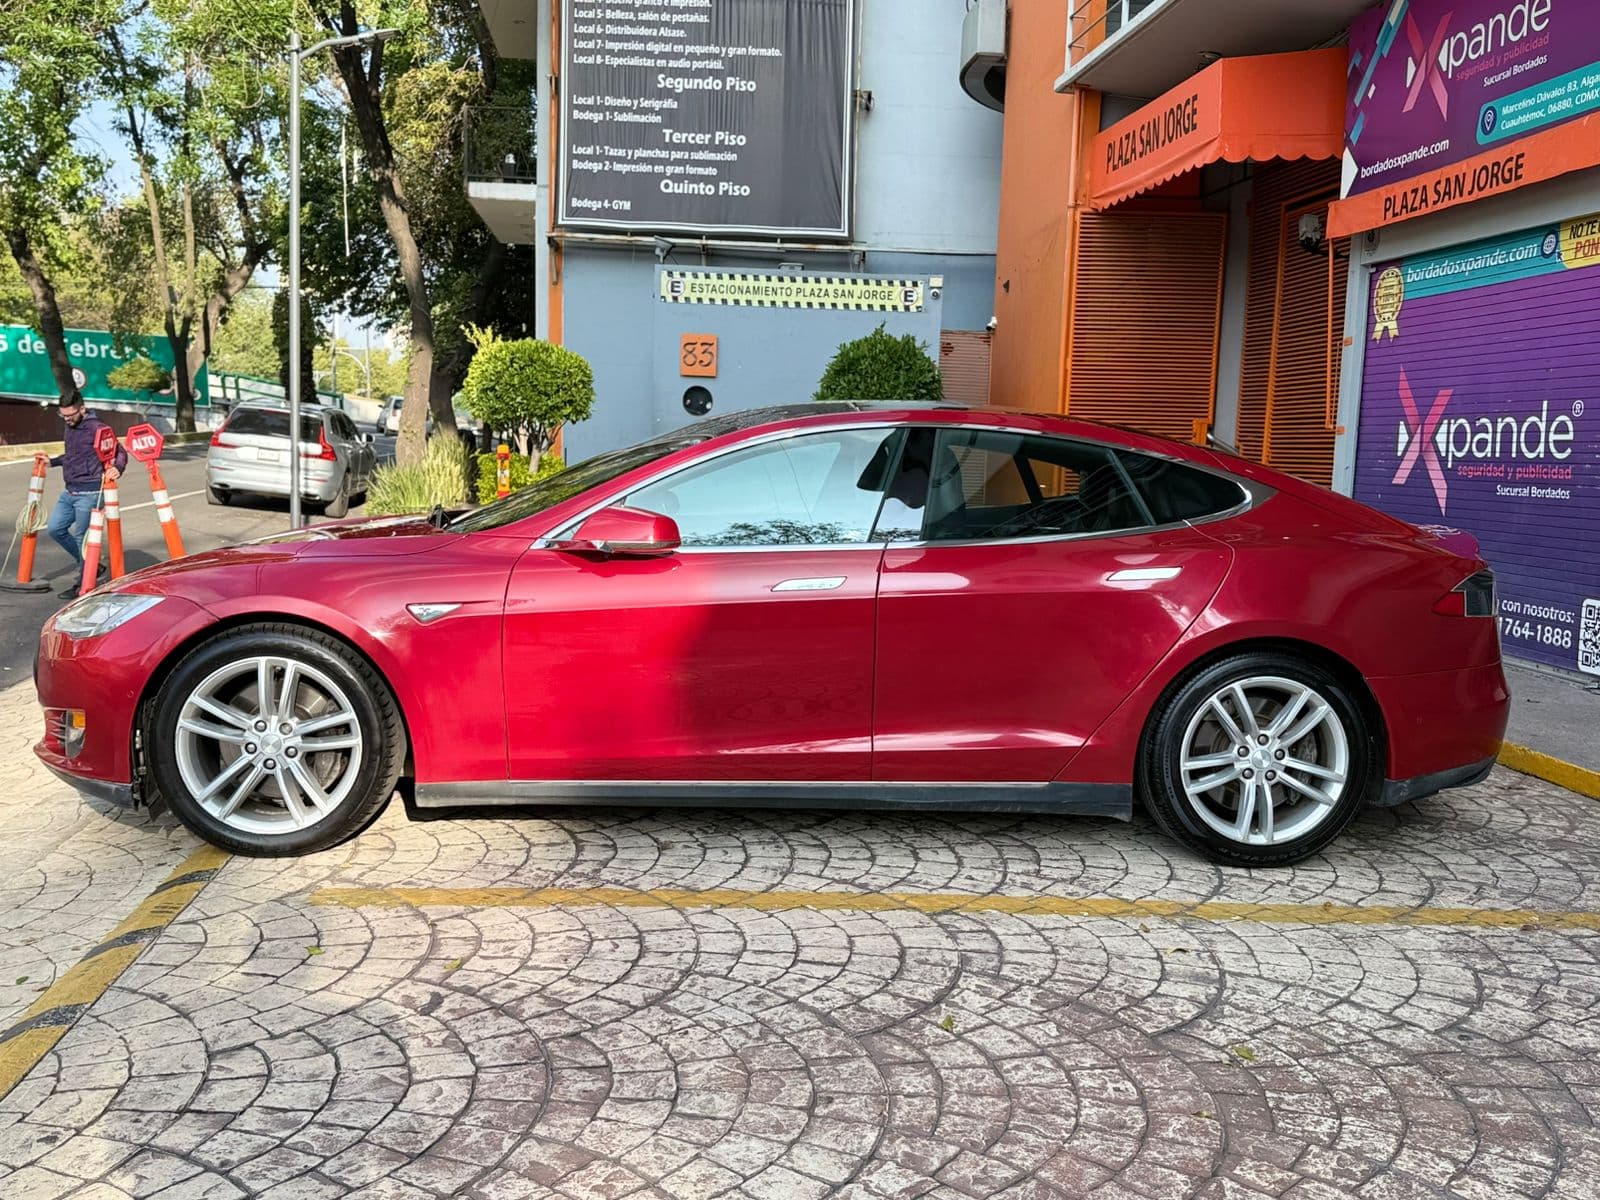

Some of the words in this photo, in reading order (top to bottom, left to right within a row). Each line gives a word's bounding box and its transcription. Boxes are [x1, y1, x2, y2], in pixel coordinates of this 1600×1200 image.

[574, 8, 595, 18] Local
[606, 9, 636, 21] Belleza,
[638, 11, 659, 21] salón
[661, 12, 671, 21] de
[672, 13, 710, 24] pestañas.
[574, 23, 595, 33] Local
[605, 24, 657, 36] Distribuidora
[574, 38, 595, 48] Local
[605, 40, 645, 52] Impresión
[646, 42, 672, 54] digital
[673, 44, 684, 52] en
[685, 44, 720, 56] pequeño
[721, 46, 727, 57] y
[728, 47, 747, 57] gran
[748, 45, 783, 56] formato.
[1503, 31, 1551, 63] publicidad
[573, 54, 595, 64] Local
[605, 55, 655, 68] Especialistas
[656, 59, 667, 67] en
[668, 58, 691, 68] audio
[692, 59, 725, 71] portátil.
[1483, 66, 1512, 87] Sucursal
[1512, 54, 1548, 76] Bordados
[657, 74, 722, 93] Segundo
[726, 77, 757, 92] Piso
[1580, 73, 1600, 89] Alga
[573, 95, 594, 105] Local
[605, 96, 632, 107] Diseño
[633, 99, 639, 109] y
[573, 110, 603, 123] Bodega
[614, 112, 662, 123] Sublimación
[662, 129, 711, 144] Tercer
[715, 131, 746, 145] Piso
[1106, 130, 1137, 174] PLAZA
[1138, 115, 1160, 158] SAN
[1161, 93, 1198, 147] JORGE
[572, 144, 594, 155] Local
[604, 146, 626, 157] Tazas
[627, 149, 633, 159] y
[634, 148, 669, 160] planchas
[671, 151, 689, 161] para
[690, 150, 738, 161] sublimación
[1360, 138, 1450, 179] bordadosxpande.com
[572, 160, 602, 173] Bodega
[613, 162, 652, 174] Impresión
[654, 165, 665, 173] en
[665, 166, 684, 176] gran
[686, 164, 718, 176] formato
[660, 179, 715, 195] Quinto
[718, 182, 751, 196] Piso
[1383, 183, 1429, 221] PLAZA
[1432, 171, 1466, 205] SAN
[1467, 152, 1526, 196] JORGE
[571, 198, 602, 211] Bodega
[612, 199, 631, 210] GYM
[1569, 222, 1584, 240] NO
[1406, 242, 1538, 283] bordadosxpande.com
[670, 280, 681, 293] E
[690, 282, 793, 297] ESTACIONAMIENTO
[795, 287, 830, 299] PLAZA
[833, 288, 855, 299] SAN
[857, 289, 894, 301] JORGE
[904, 290, 915, 303] E
[18, 334, 47, 354] de
[63, 338, 150, 359] ebrr
[682, 342, 715, 367] 83
[131, 435, 157, 451] ALTO
[1457, 464, 1505, 479] seguridad
[1507, 467, 1514, 480] y
[1516, 464, 1573, 480] publicidad
[1496, 485, 1530, 497] Sucursal
[1531, 486, 1571, 499] Bordados
[1501, 600, 1521, 613] con
[1523, 604, 1576, 623] nosotros:
